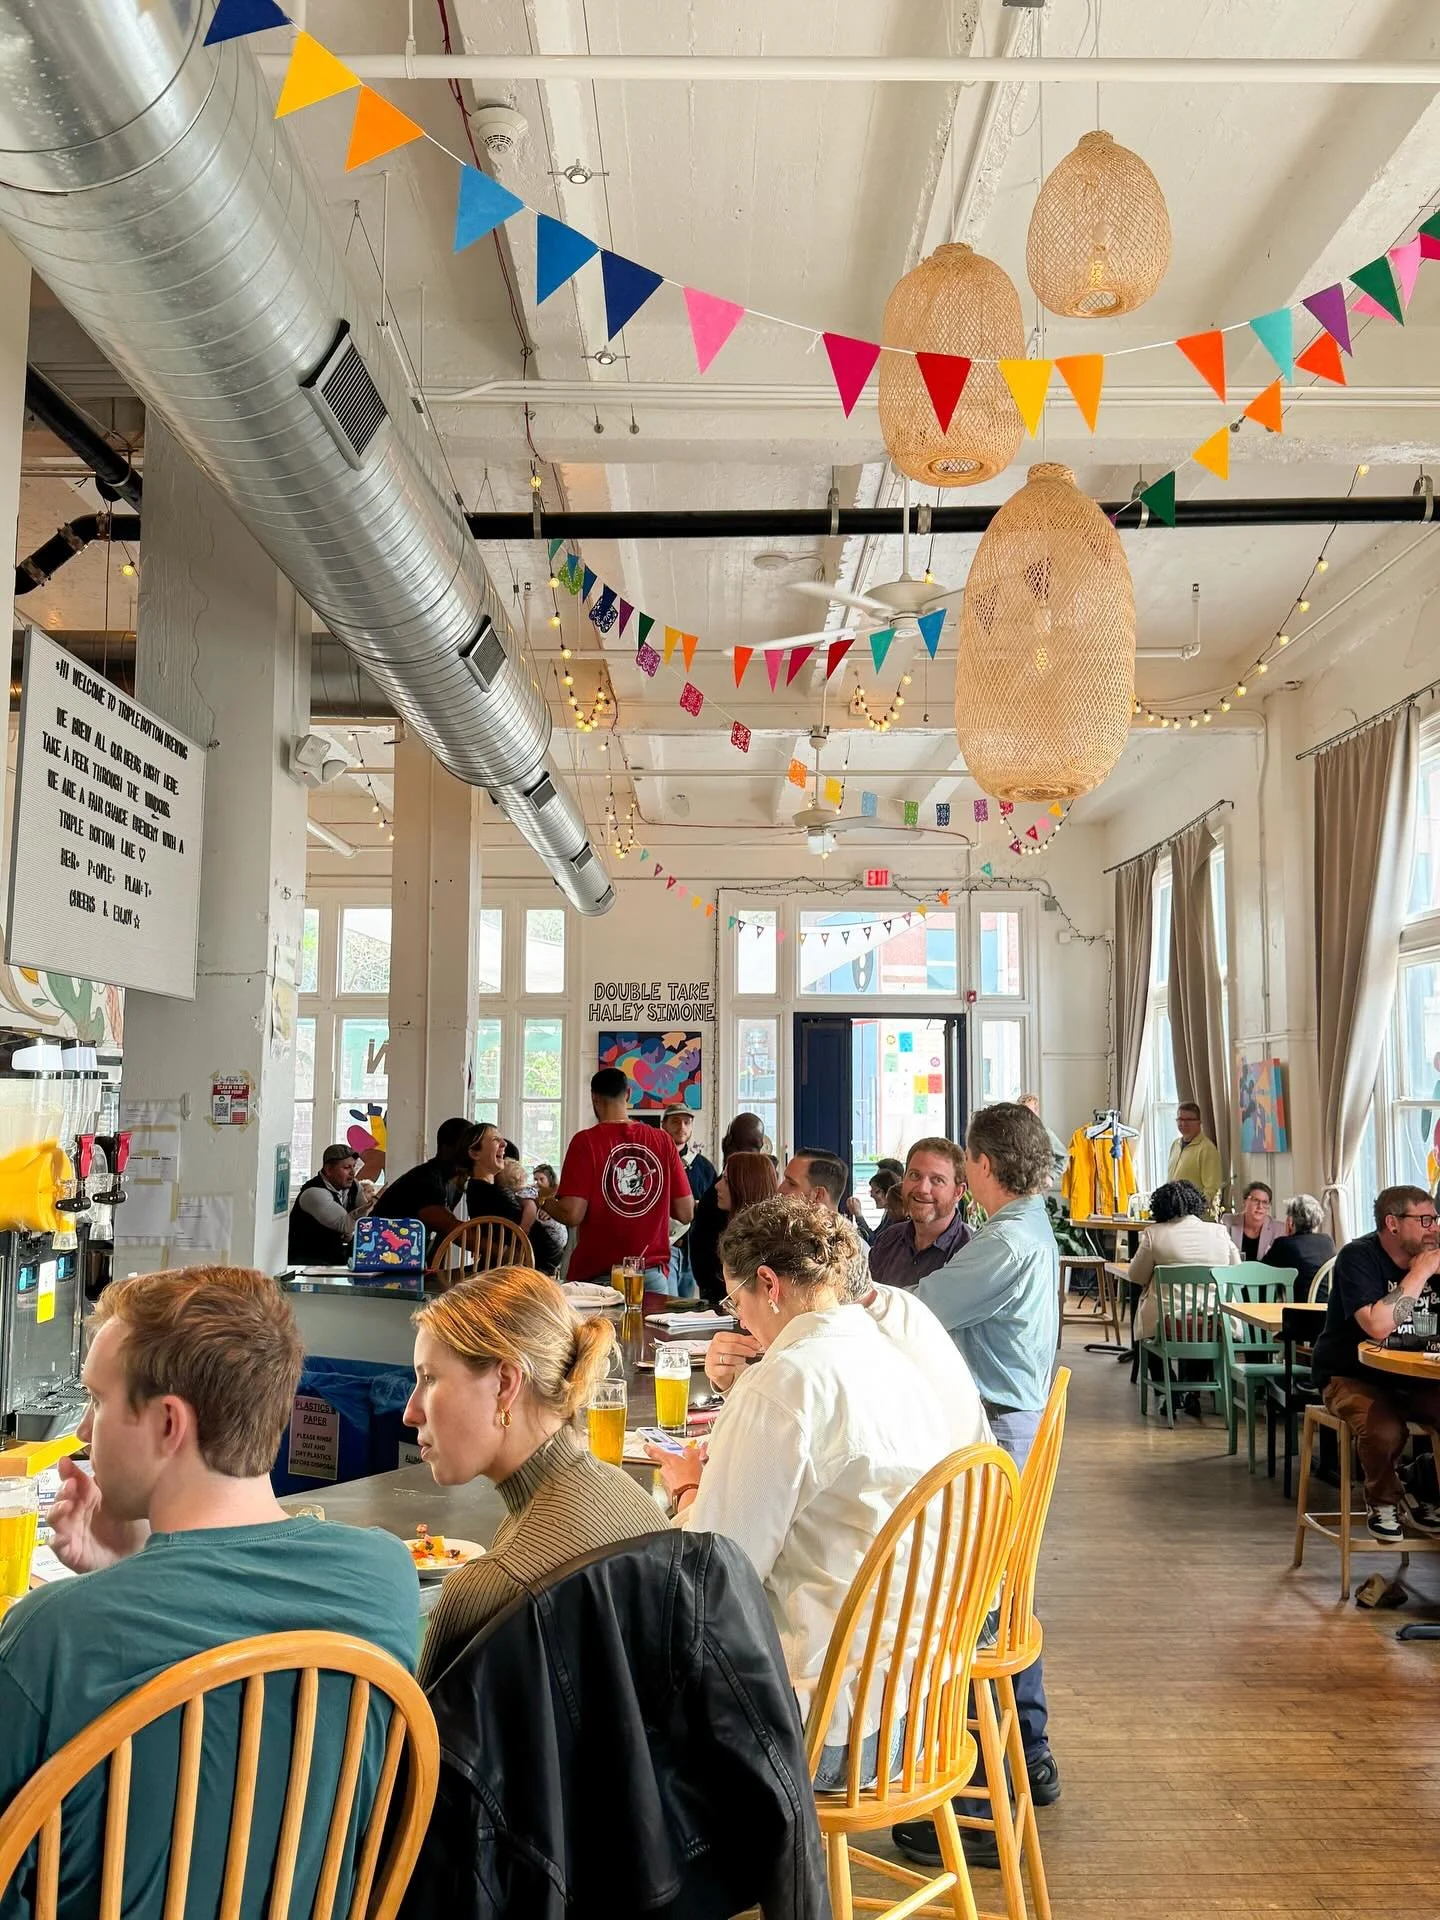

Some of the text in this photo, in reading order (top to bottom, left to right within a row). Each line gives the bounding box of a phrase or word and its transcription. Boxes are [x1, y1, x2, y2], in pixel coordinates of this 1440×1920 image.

[72, 667, 106, 705] WELCOME
[107, 691, 116, 712] TO
[118, 699, 141, 729] TRIPLE
[140, 715, 164, 745] BOTTOM
[163, 730, 188, 760] BREWING
[56, 707, 68, 728] WE
[71, 717, 92, 742] BREW
[94, 731, 107, 753] ALL
[110, 741, 122, 762] OUR
[123, 748, 141, 774] BEERS
[143, 762, 161, 785] RIGHT
[42, 731, 62, 758] TAKE
[63, 745, 70, 763] A
[71, 749, 89, 774] PEEK
[92, 762, 123, 792] THROUGH
[127, 780, 139, 802] THE
[47, 768, 184, 854] WE ARE A FAIR CHANCE BREWERY WITH A
[59, 809, 136, 859] TRIPLE BOTTOM LINE
[868, 870, 888, 886] EXIT
[69, 889, 96, 913] CHEERS
[113, 904, 133, 925] ENJOY
[594, 982, 710, 1001] DOUBLE TAKE
[588, 1003, 716, 1022] HALEY SIMONE
[296, 1400, 330, 1412] PLASTICS
[303, 1414, 327, 1425] PAPER
